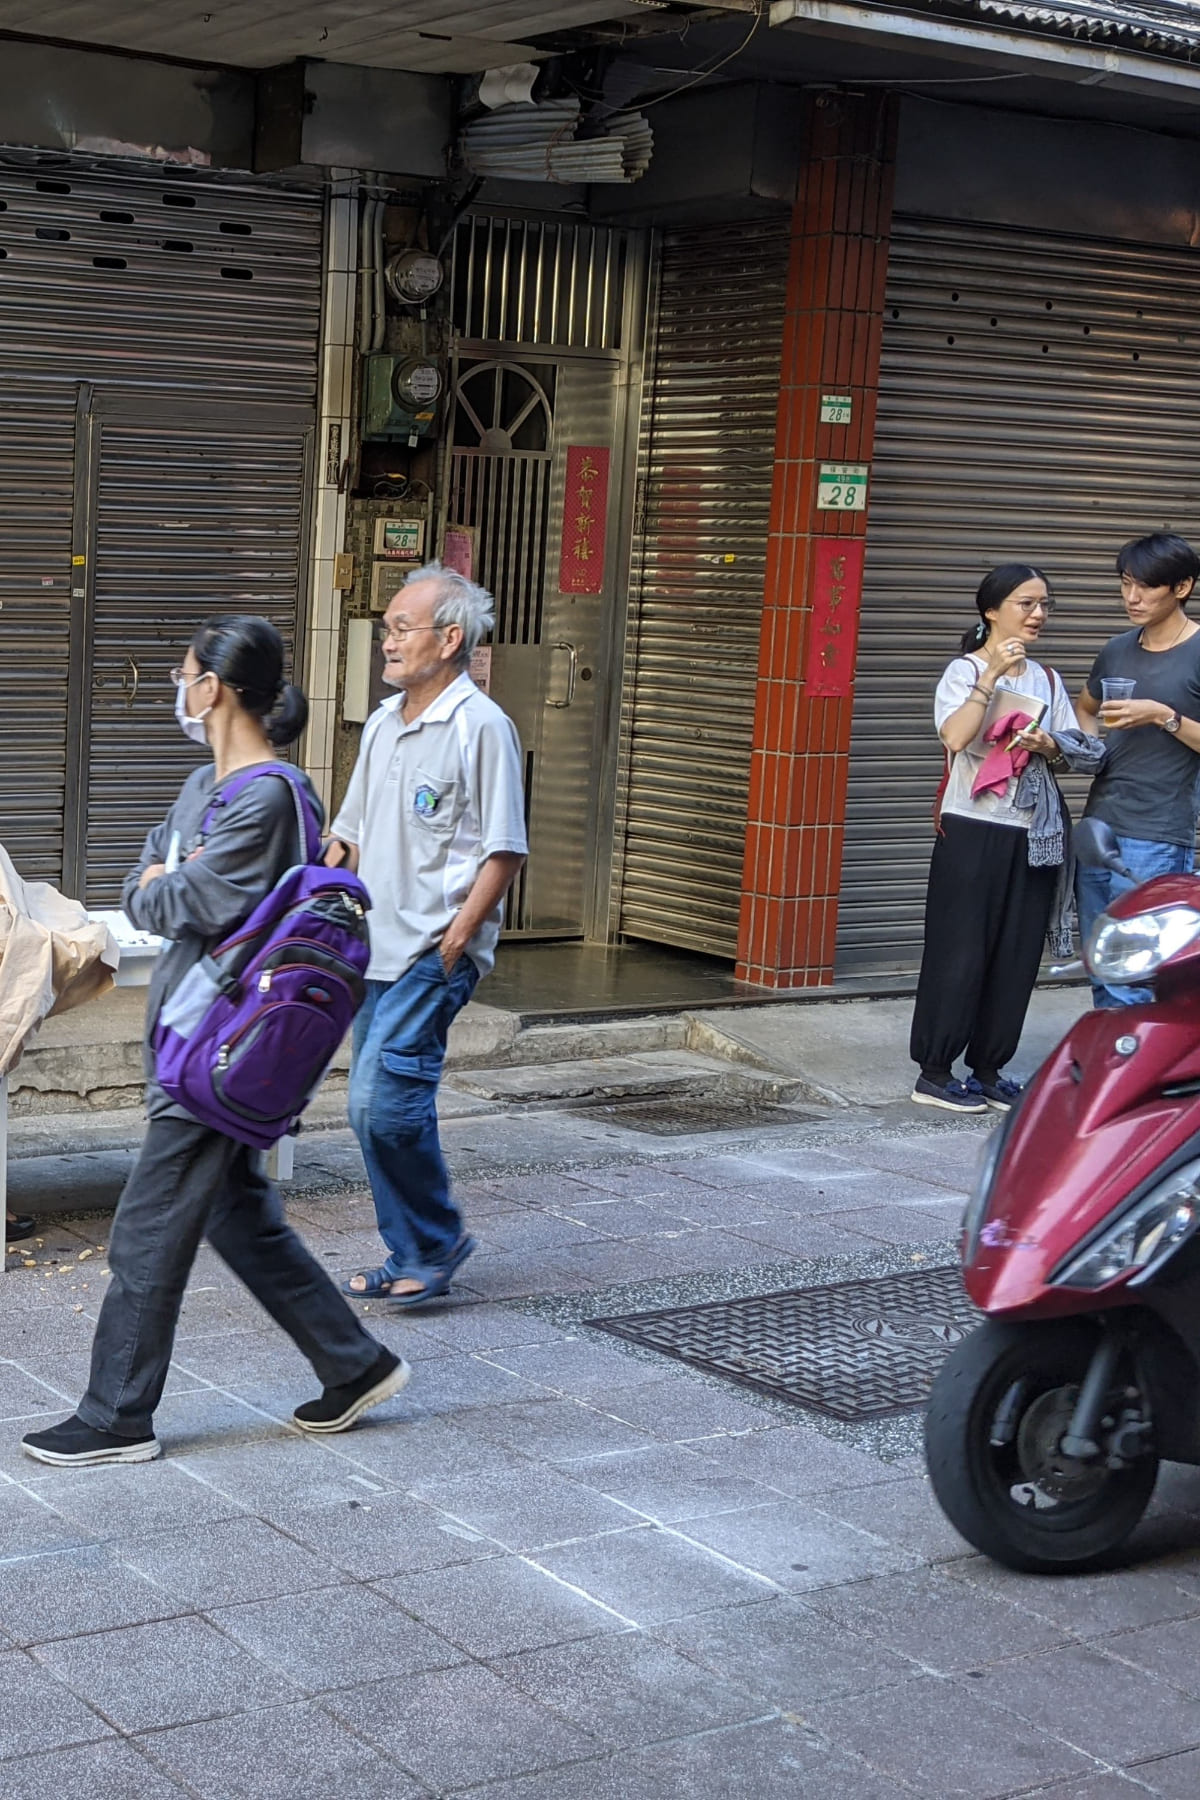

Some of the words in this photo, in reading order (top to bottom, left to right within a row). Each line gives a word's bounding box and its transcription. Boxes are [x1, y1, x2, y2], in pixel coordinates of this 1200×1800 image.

[828, 407, 843, 421] 28
[828, 486, 857, 507] 28
[393, 534, 409, 547] 28
